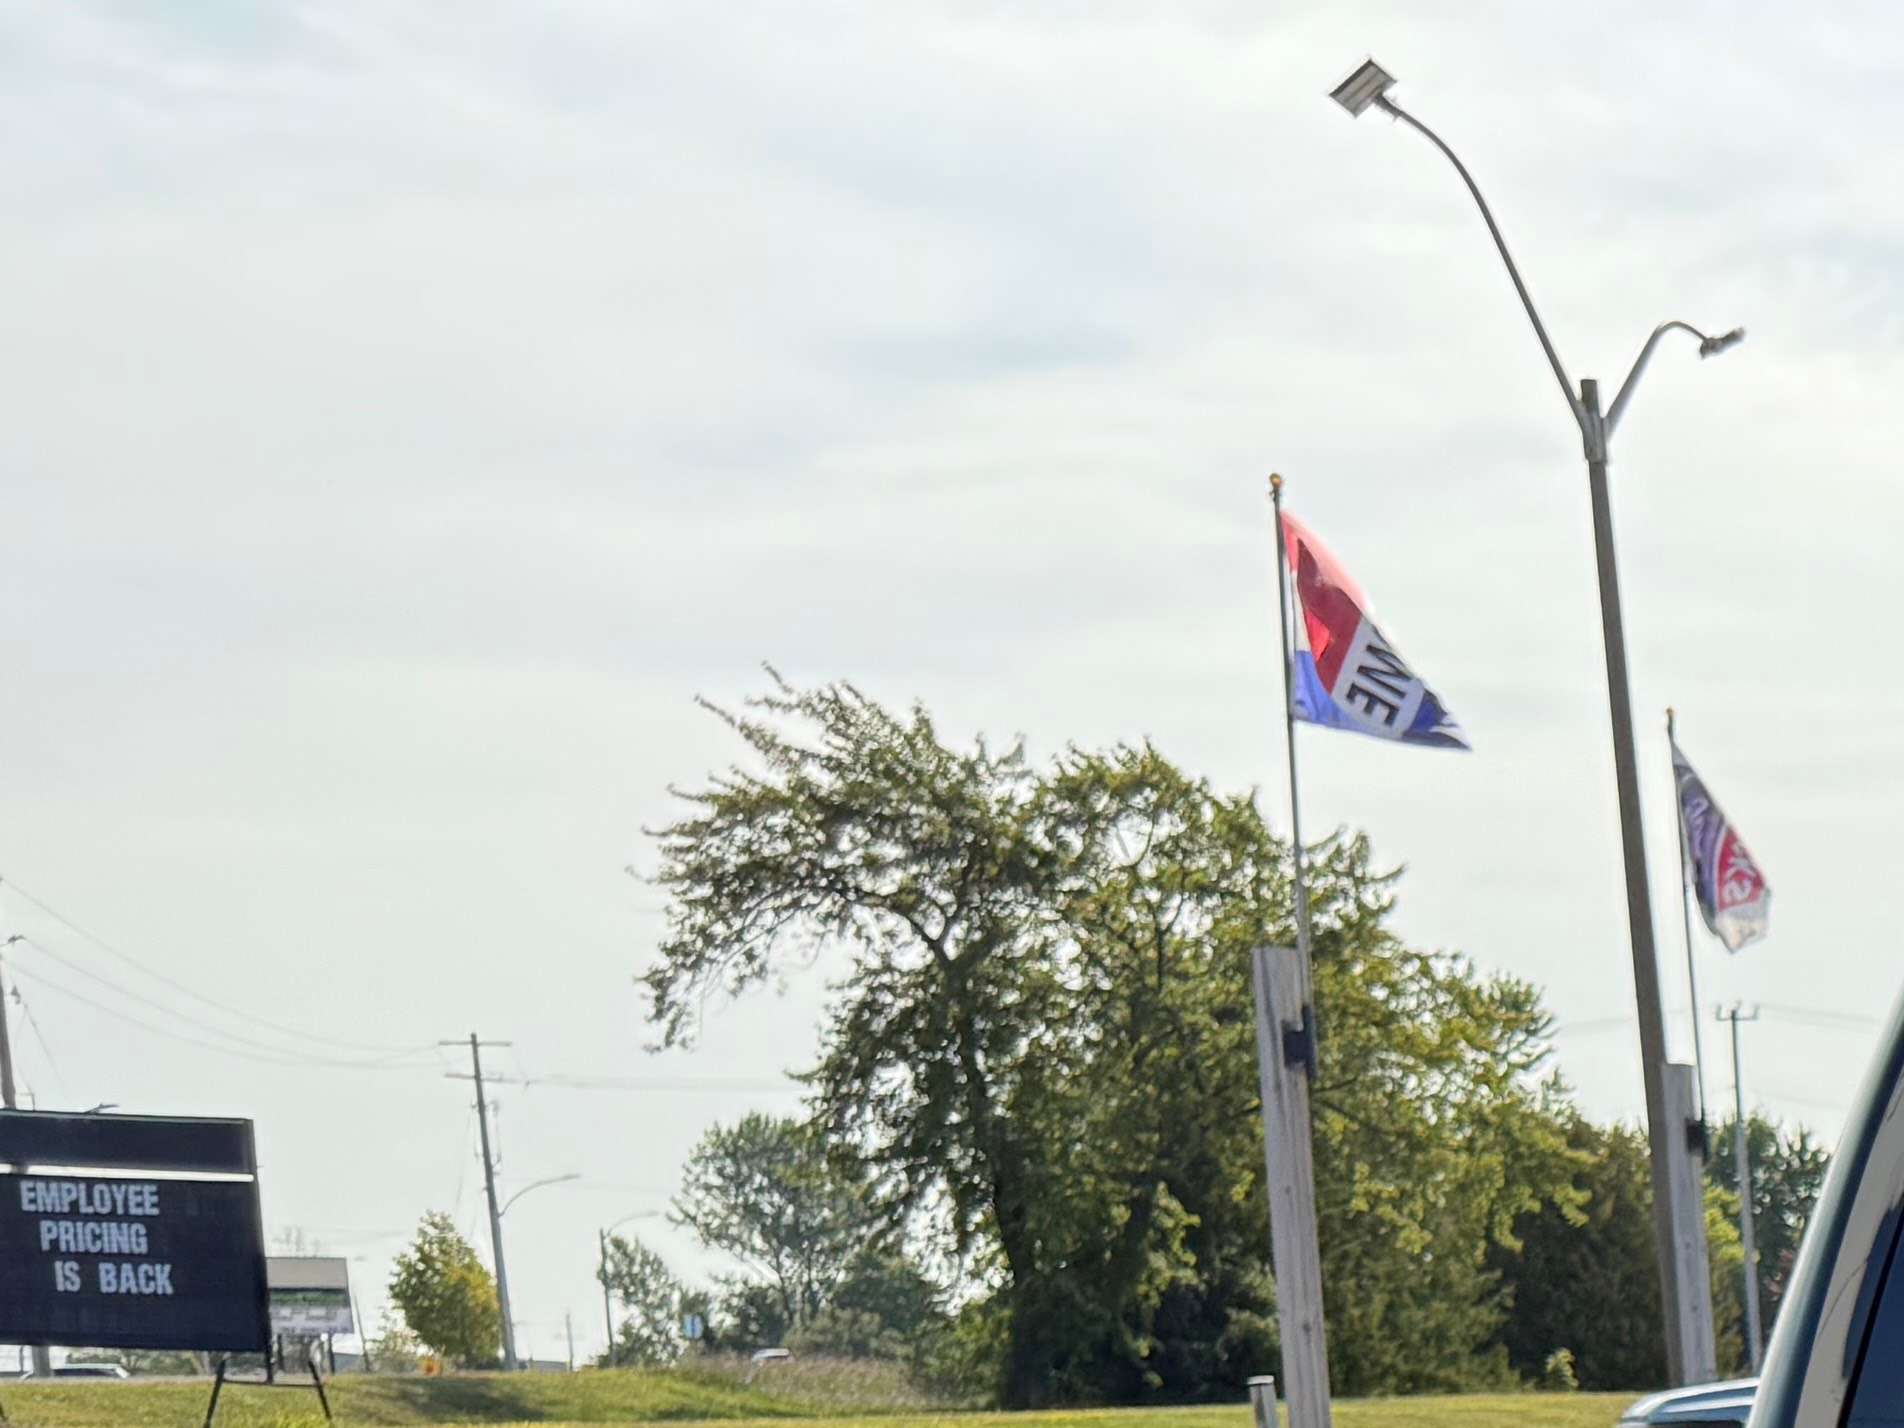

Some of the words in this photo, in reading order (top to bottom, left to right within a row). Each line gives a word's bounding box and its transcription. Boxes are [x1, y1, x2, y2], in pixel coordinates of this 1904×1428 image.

[20, 1180, 160, 1216] EMPLOYEE
[39, 1219, 149, 1255] PRICING
[54, 1260, 81, 1292] IS
[98, 1261, 174, 1295] BACK
